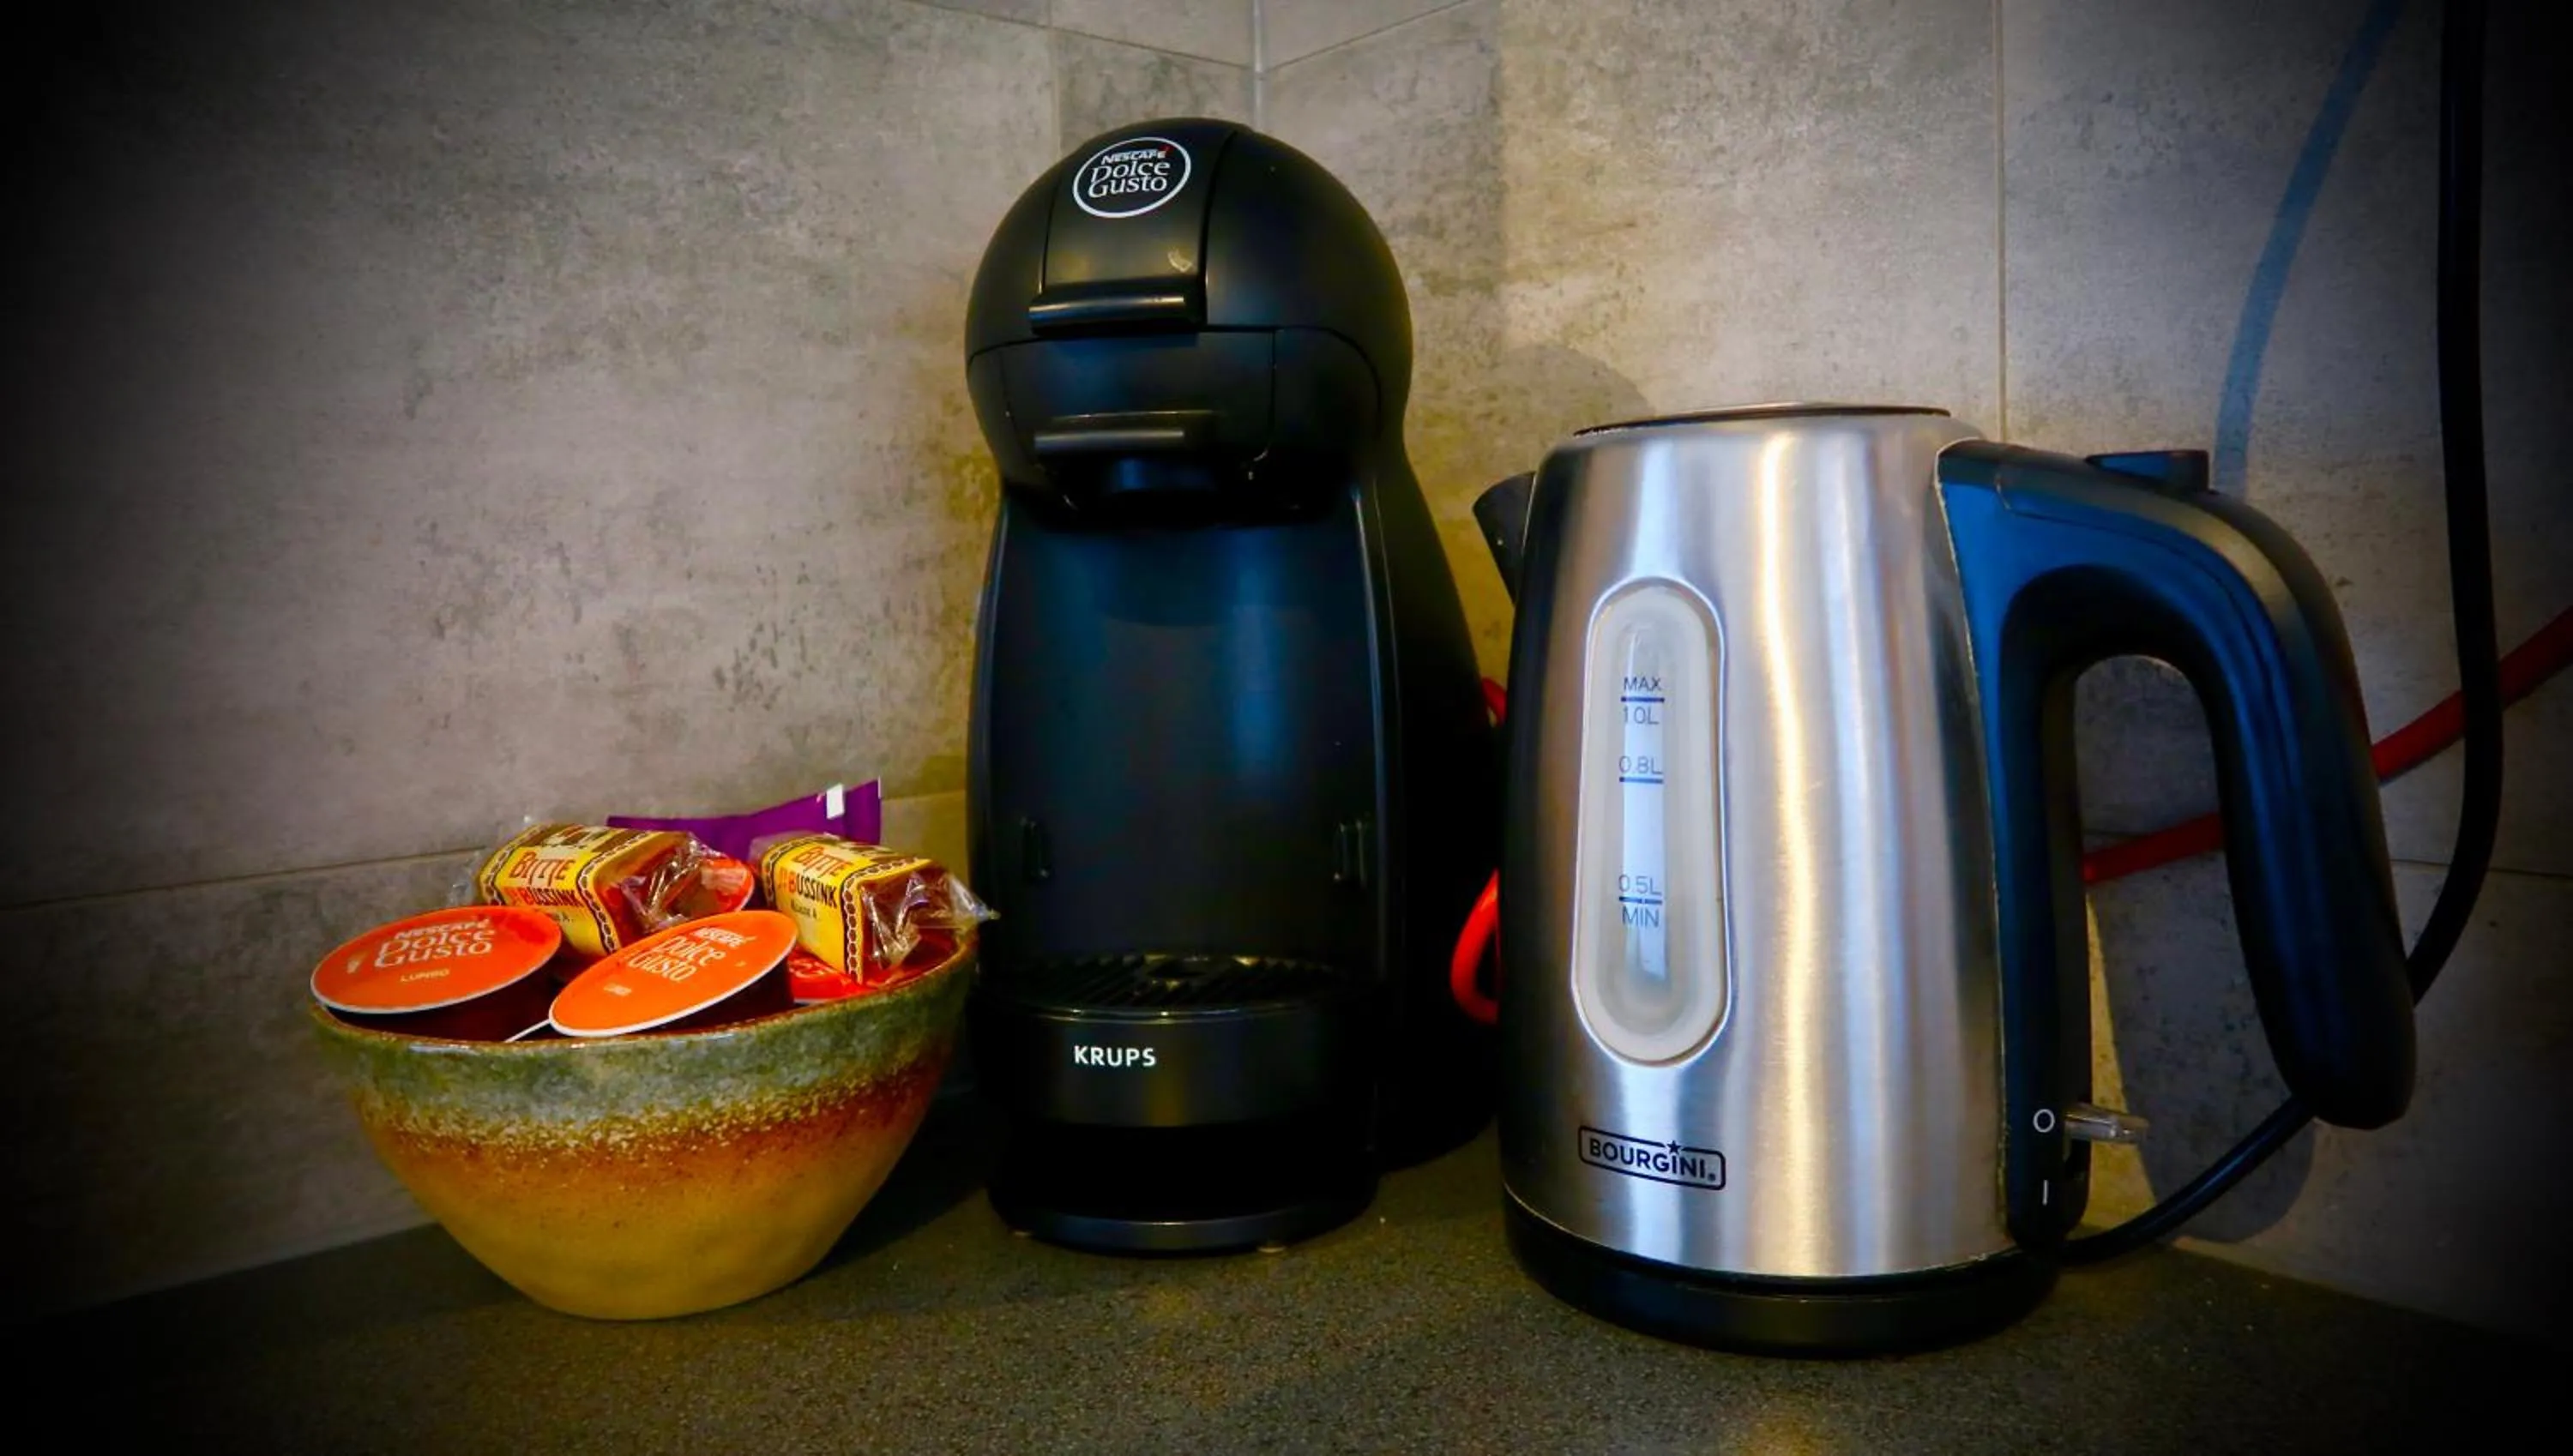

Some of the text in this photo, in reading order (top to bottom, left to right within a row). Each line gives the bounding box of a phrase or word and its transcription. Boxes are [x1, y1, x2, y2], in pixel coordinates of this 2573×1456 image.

[1623, 676, 1662, 692] MAX
[1622, 905, 1660, 928] MIN
[1073, 1044, 1157, 1068] KRUPS
[1588, 1136, 1706, 1180] BOURGINI
